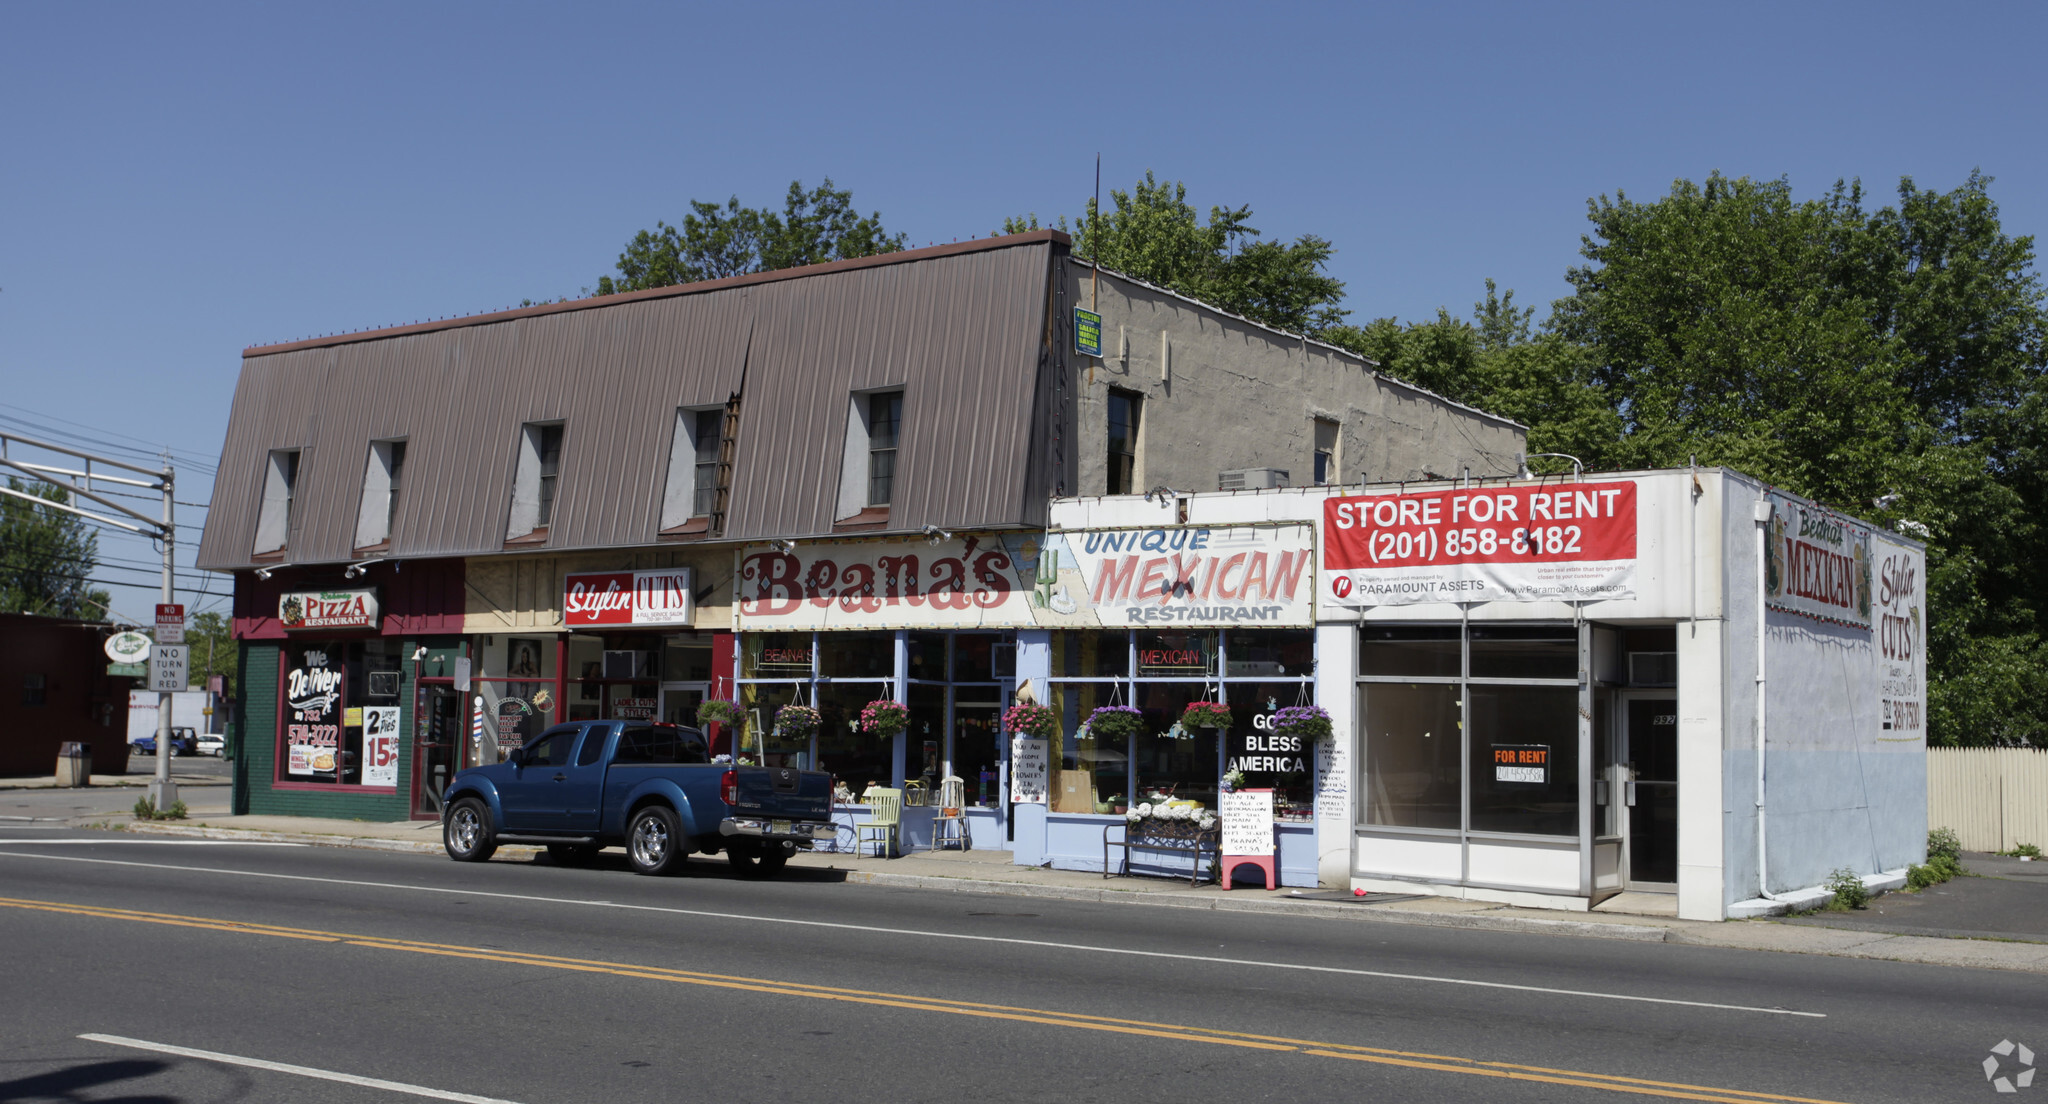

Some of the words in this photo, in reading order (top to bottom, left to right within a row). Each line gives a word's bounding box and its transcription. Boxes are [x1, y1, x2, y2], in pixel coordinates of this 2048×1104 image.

[1336, 499, 1442, 530] STORE
[1453, 494, 1519, 523] FOR
[1530, 489, 1621, 521] RENT
[1084, 529, 1212, 554] UNIQUE
[1369, 527, 1438, 564] (201)
[1445, 525, 1582, 557] 858-8182
[740, 536, 1011, 616] Beana's
[1087, 548, 1312, 607] MEXICAN
[1785, 536, 1854, 609] MEXICAN
[1359, 582, 1436, 595] PARAMOUNT
[1439, 580, 1485, 592] ASSETS
[1504, 585, 1627, 595] www.ParamountAssets.com
[1880, 553, 1915, 615] Stylin
[566, 579, 631, 620] Stylin
[636, 574, 684, 611] CUTS
[164, 606, 175, 614] NO
[306, 595, 366, 618] PIZZA
[1126, 605, 1284, 624] RESTAURANT
[157, 615, 182, 624] PARKING
[305, 616, 367, 626] RESTAURANT
[1881, 613, 1912, 661] CUTS
[160, 649, 179, 658] NO
[304, 650, 328, 667] We
[764, 648, 813, 663] BEANA'S
[1141, 649, 1199, 664] MEXICAN
[288, 667, 342, 700] Deliver
[614, 698, 636, 707] LADIES
[638, 698, 657, 707] CUTS
[303, 708, 321, 722] 732
[623, 708, 650, 717] STYLES
[1653, 714, 1676, 725] 992
[367, 710, 381, 735] 2
[382, 709, 397, 720] Large
[380, 719, 397, 734] Pies
[1253, 714, 1276, 730] GO
[1246, 736, 1302, 752] BLESS
[1227, 756, 1305, 773] AMERICA
[1495, 750, 1516, 763] FOR
[1519, 750, 1547, 764] RENT
